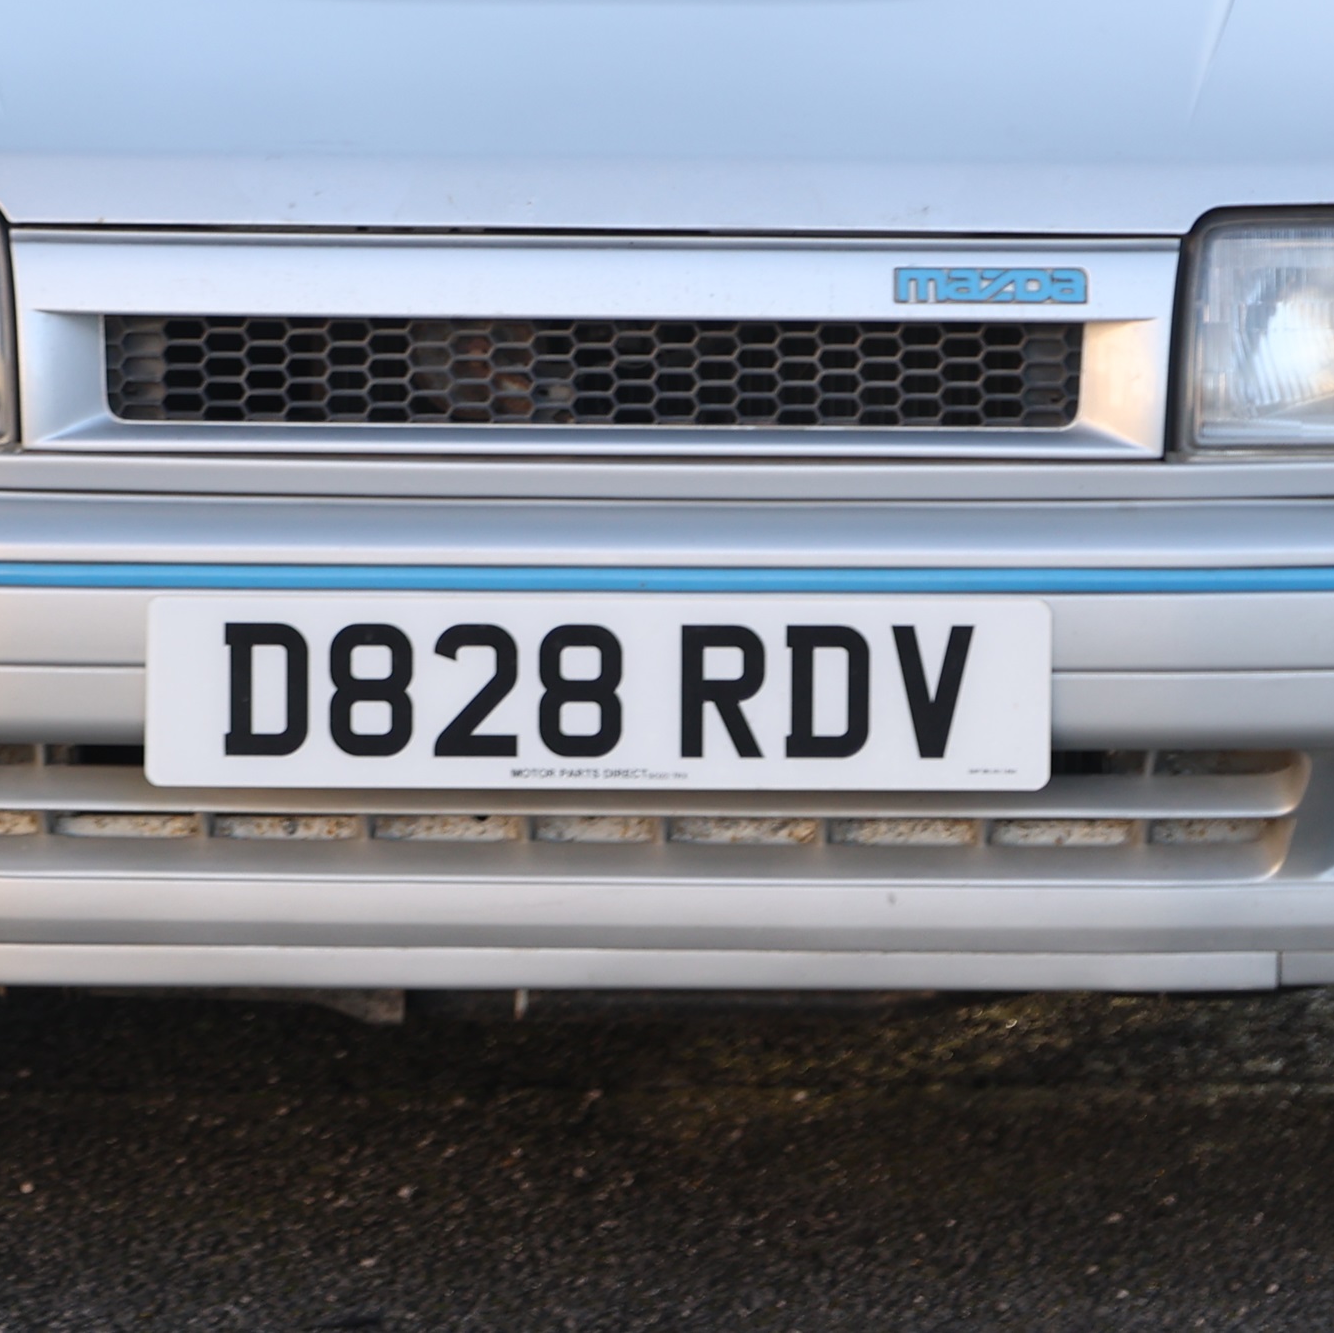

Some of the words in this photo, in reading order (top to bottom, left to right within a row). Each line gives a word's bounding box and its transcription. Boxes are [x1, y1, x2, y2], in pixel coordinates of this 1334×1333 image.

[223, 621, 623, 757] D828
[679, 624, 976, 759] RDV
[510, 768, 556, 779] MOTOR
[559, 768, 600, 779] PARTS
[603, 768, 649, 780] DIRECT
